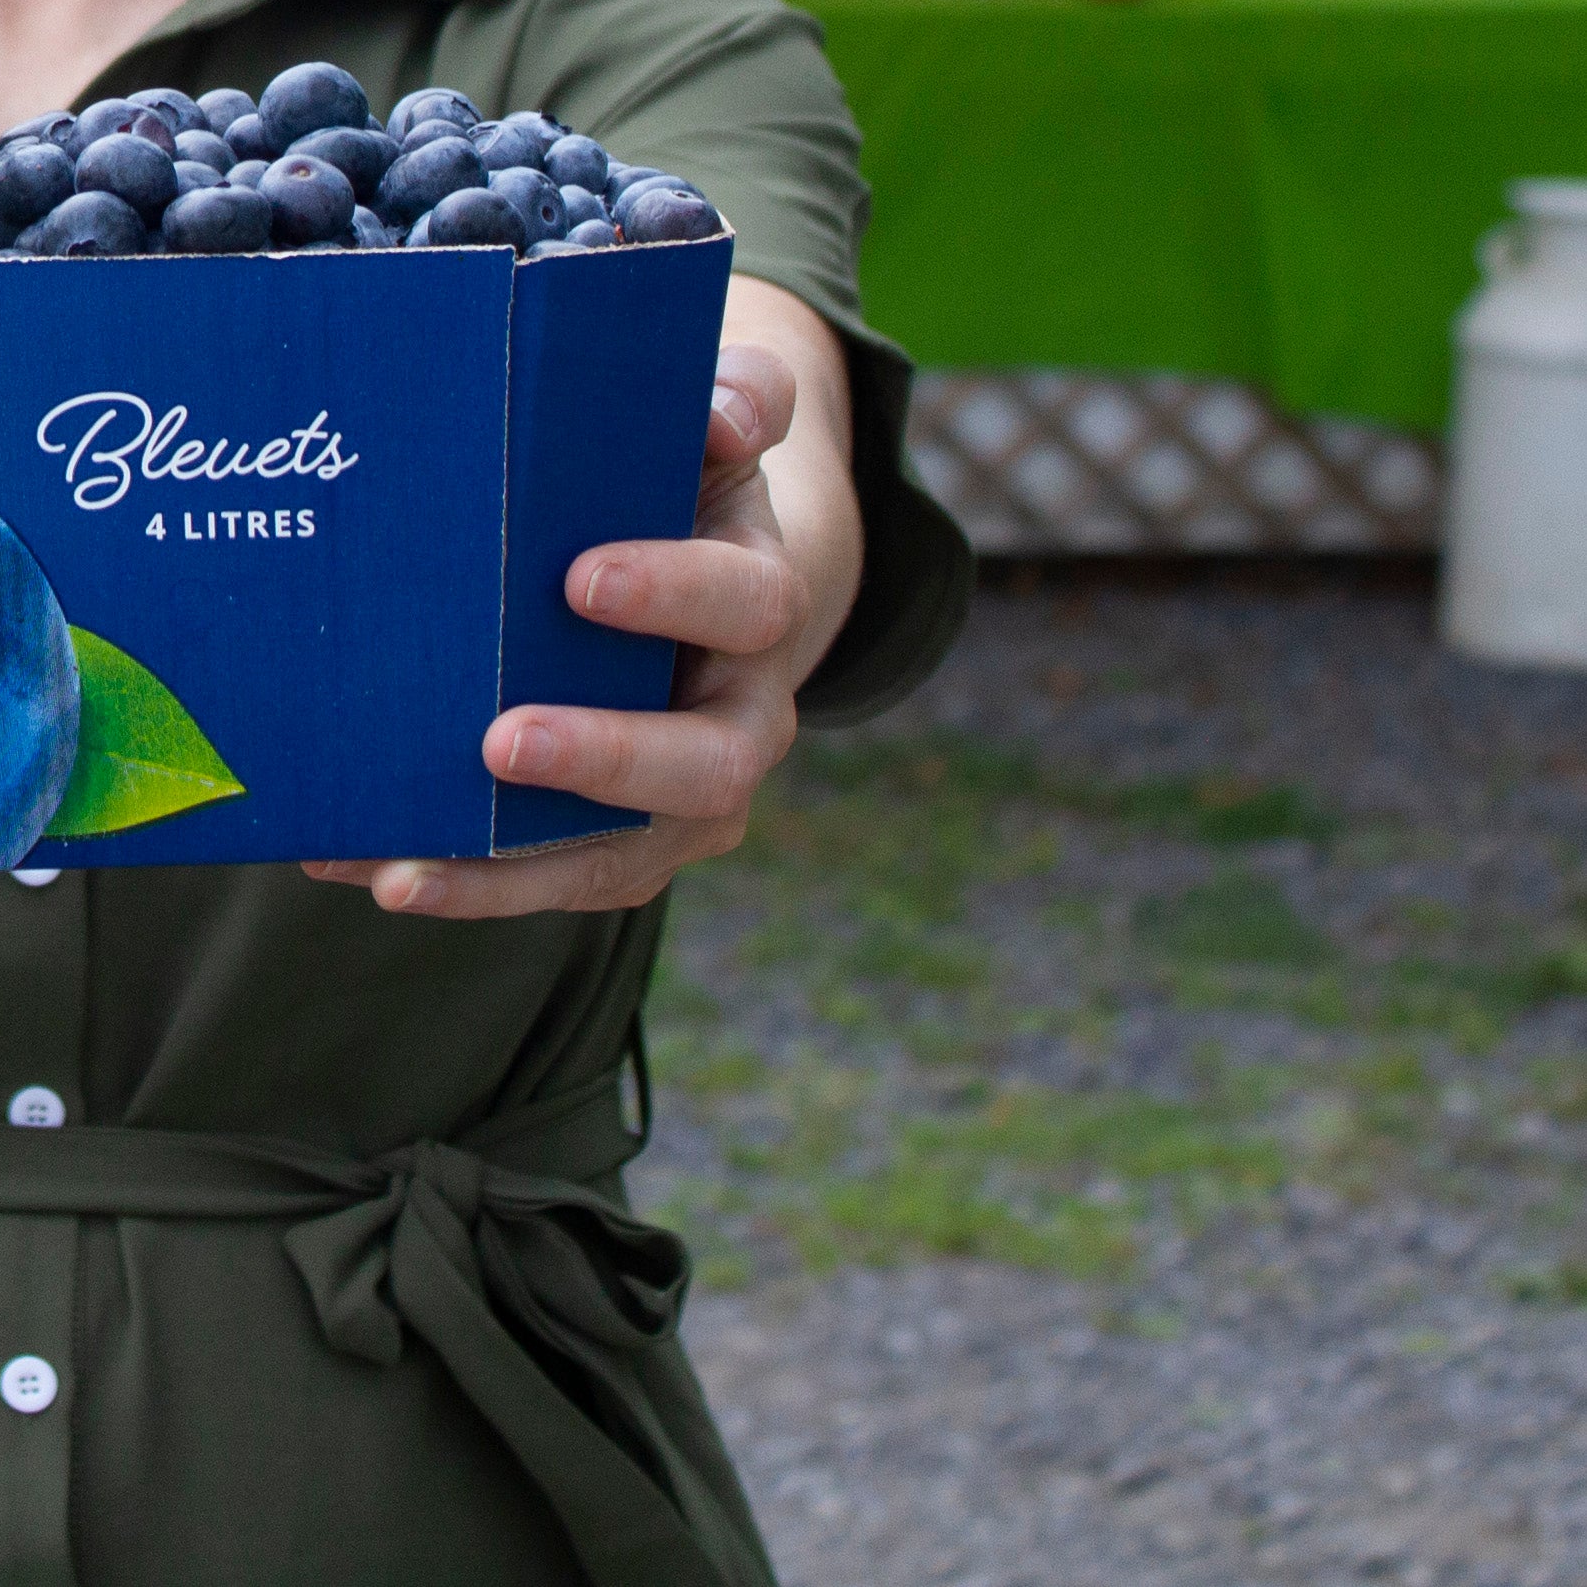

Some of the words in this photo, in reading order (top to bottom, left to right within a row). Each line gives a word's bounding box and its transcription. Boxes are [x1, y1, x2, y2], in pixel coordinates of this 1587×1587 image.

[36, 391, 359, 510] Bleuets
[145, 513, 167, 541] 4
[184, 509, 316, 540] LITRES
